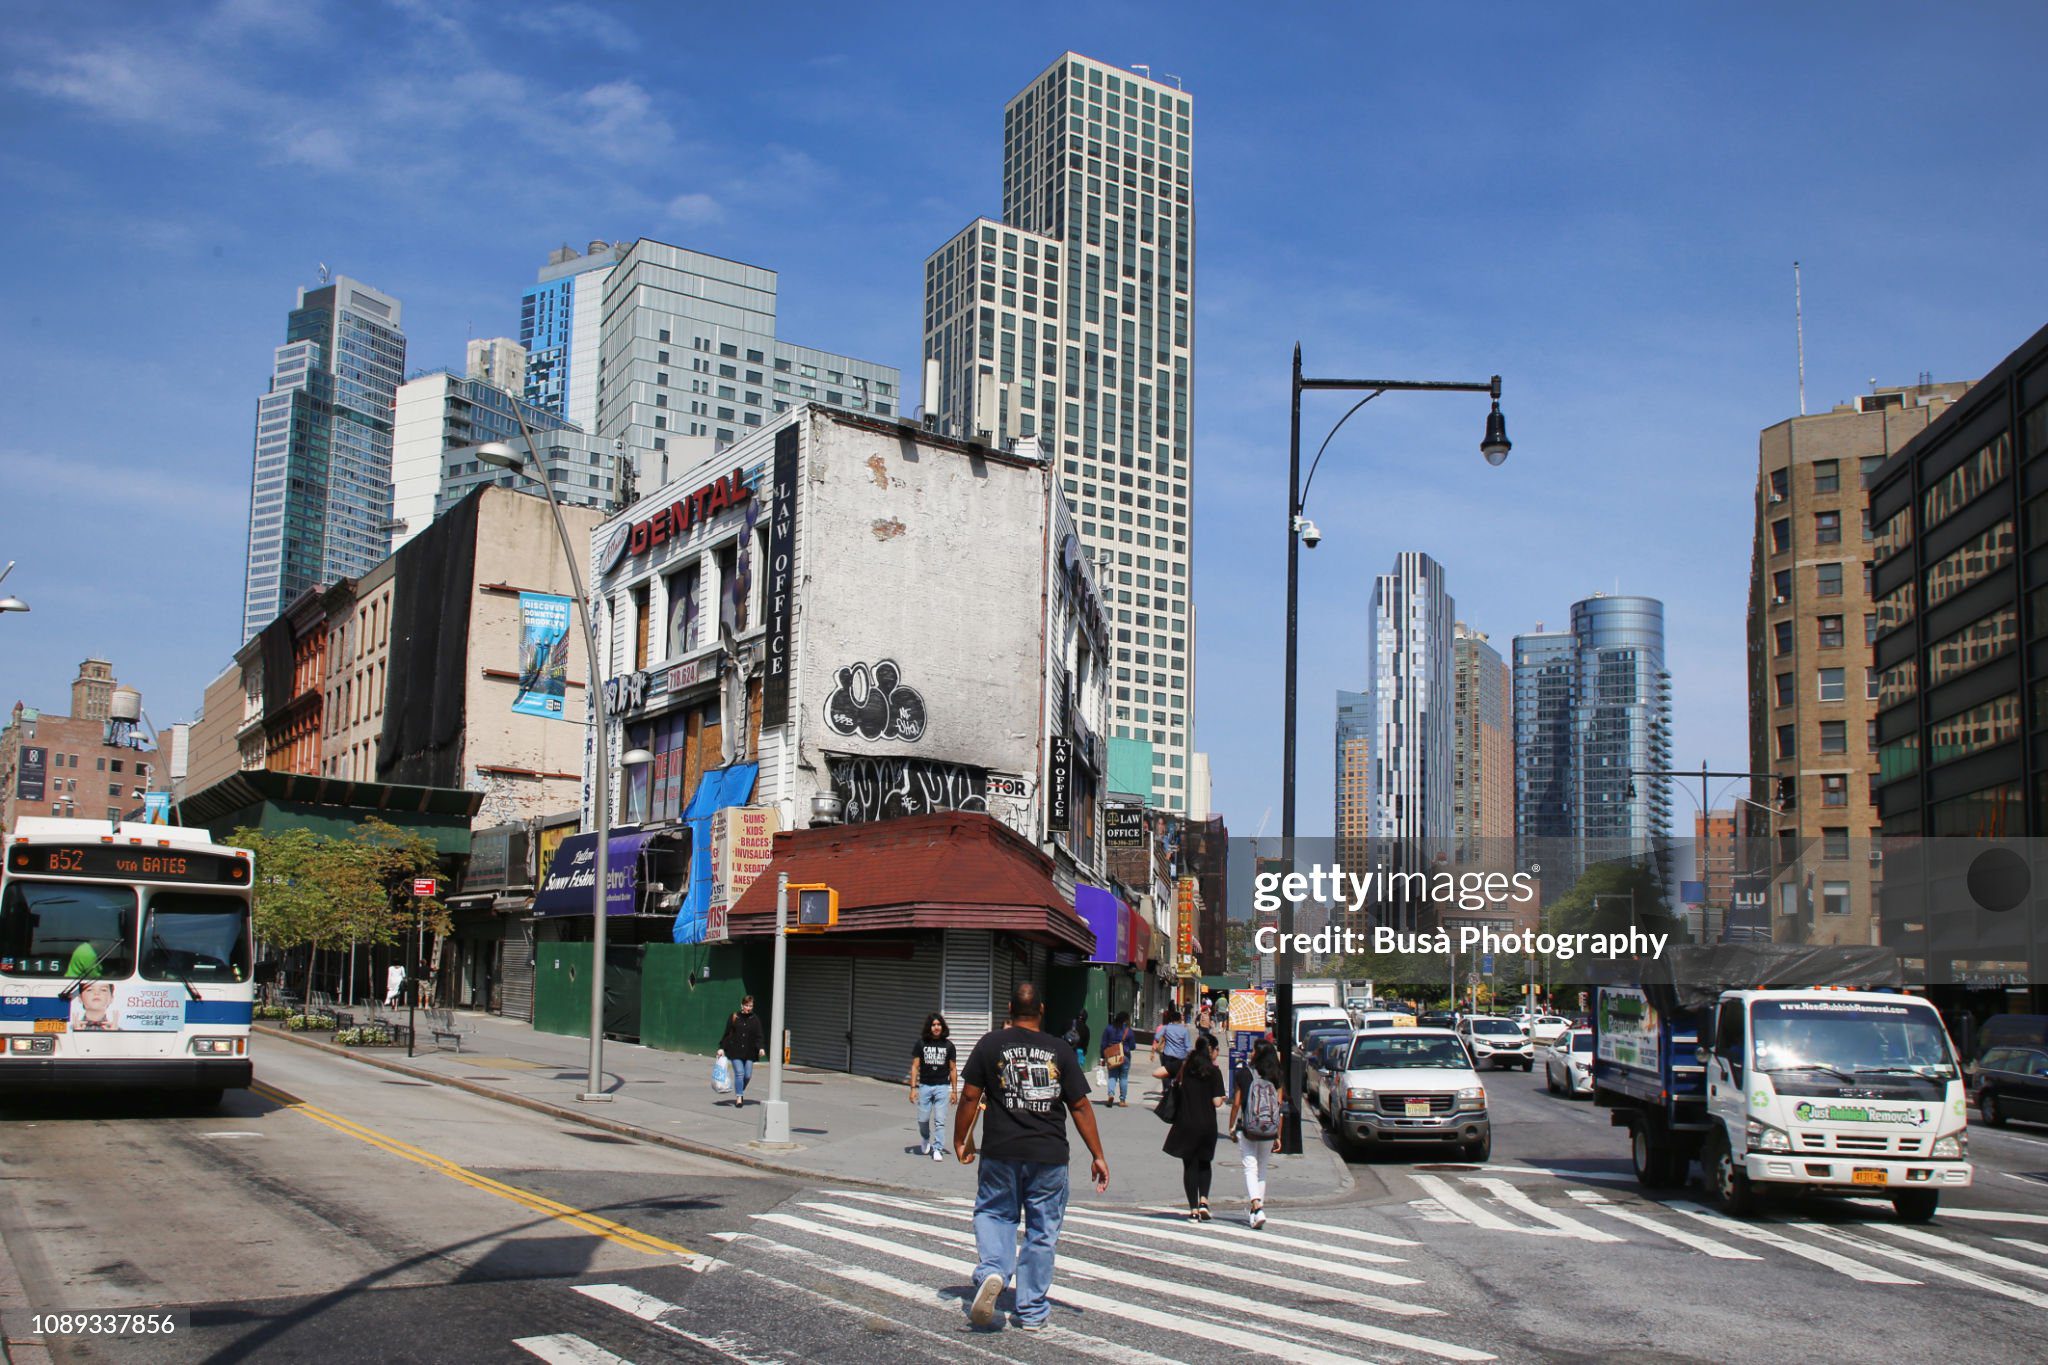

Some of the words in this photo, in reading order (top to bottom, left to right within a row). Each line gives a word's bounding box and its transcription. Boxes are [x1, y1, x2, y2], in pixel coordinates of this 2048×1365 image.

[631, 467, 749, 556] DENTAL
[777, 482, 790, 540] LAW
[525, 601, 566, 612] DISCOVER
[525, 610, 565, 620] DOWNTOWN
[771, 553, 788, 675] OFFICE
[525, 618, 564, 629] BROOKLYN
[1055, 738, 1067, 764] LAW
[1054, 768, 1067, 817] OFFICE
[743, 814, 766, 824] GUMS
[1120, 814, 1141, 824] LAW
[746, 825, 764, 836] KIDS
[1107, 828, 1140, 838] OFFICE
[740, 837, 769, 847] BRACES
[50, 849, 84, 872] B52
[142, 857, 187, 874] GATES
[140, 990, 169, 999] young
[4, 997, 29, 1006] 6508
[127, 996, 180, 1008] Sheldon
[923, 1046, 937, 1054] CAN
[1003, 1047, 1027, 1061] NEVER
[1029, 1048, 1055, 1061] ARGUE
[1006, 1098, 1014, 1108] 18
[1808, 1106, 1830, 1120] Just
[1830, 1105, 1867, 1121] Rubbish
[1868, 1108, 1911, 1124] Removal
